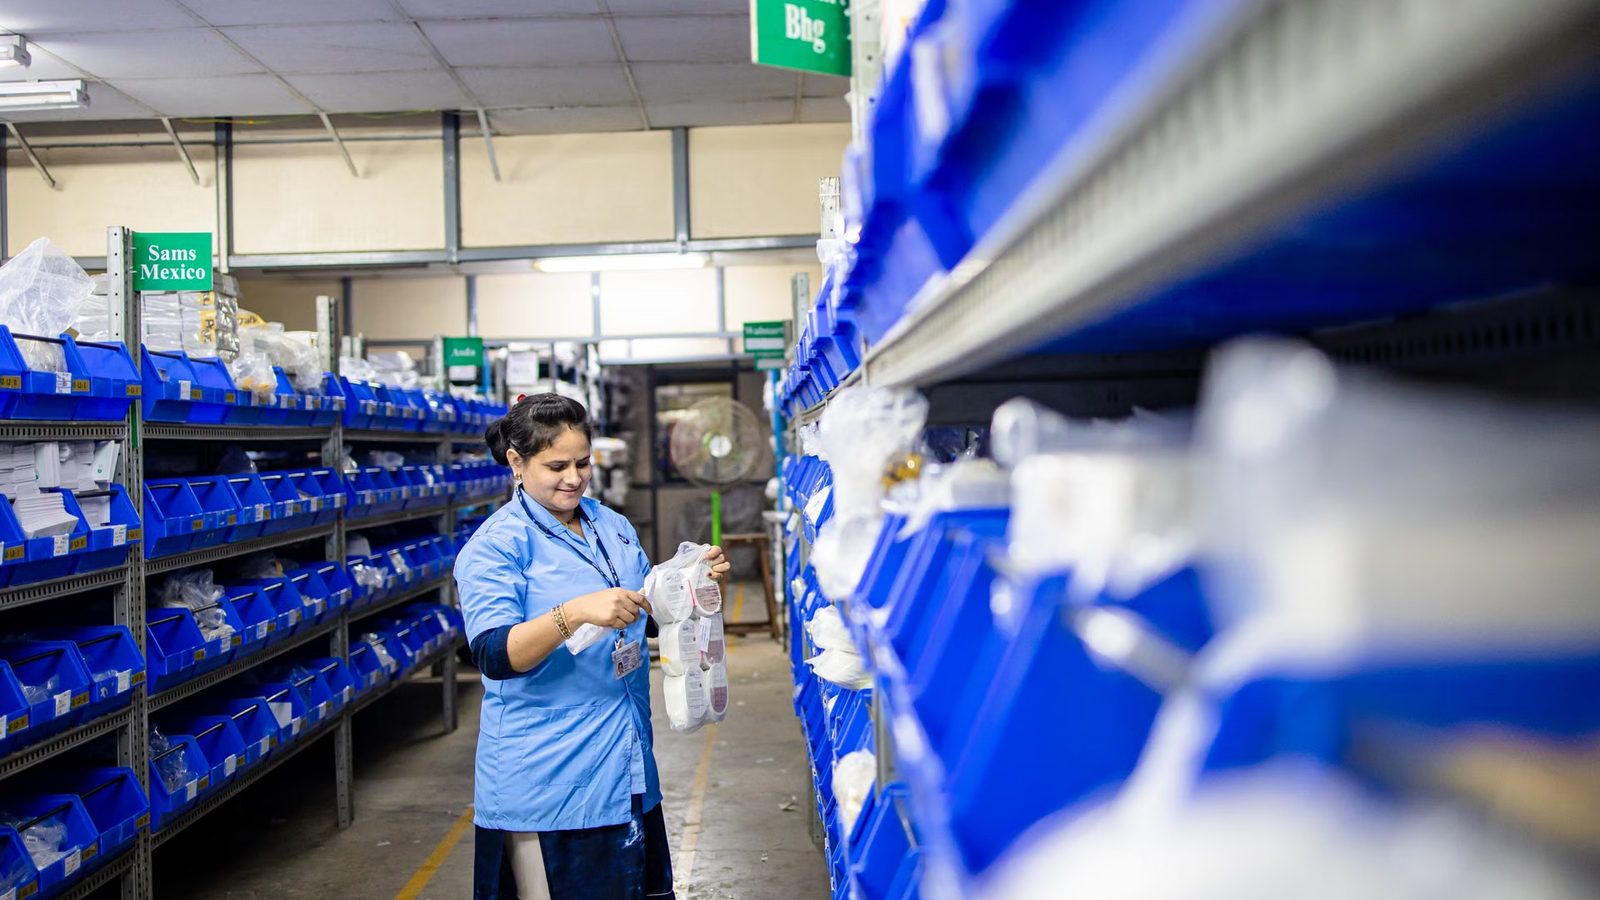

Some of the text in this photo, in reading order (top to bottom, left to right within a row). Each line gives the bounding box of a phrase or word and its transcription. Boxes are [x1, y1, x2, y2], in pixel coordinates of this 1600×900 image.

[784, 3, 826, 54] Bhg
[148, 244, 197, 261] Sams
[140, 263, 206, 280] Mexico
